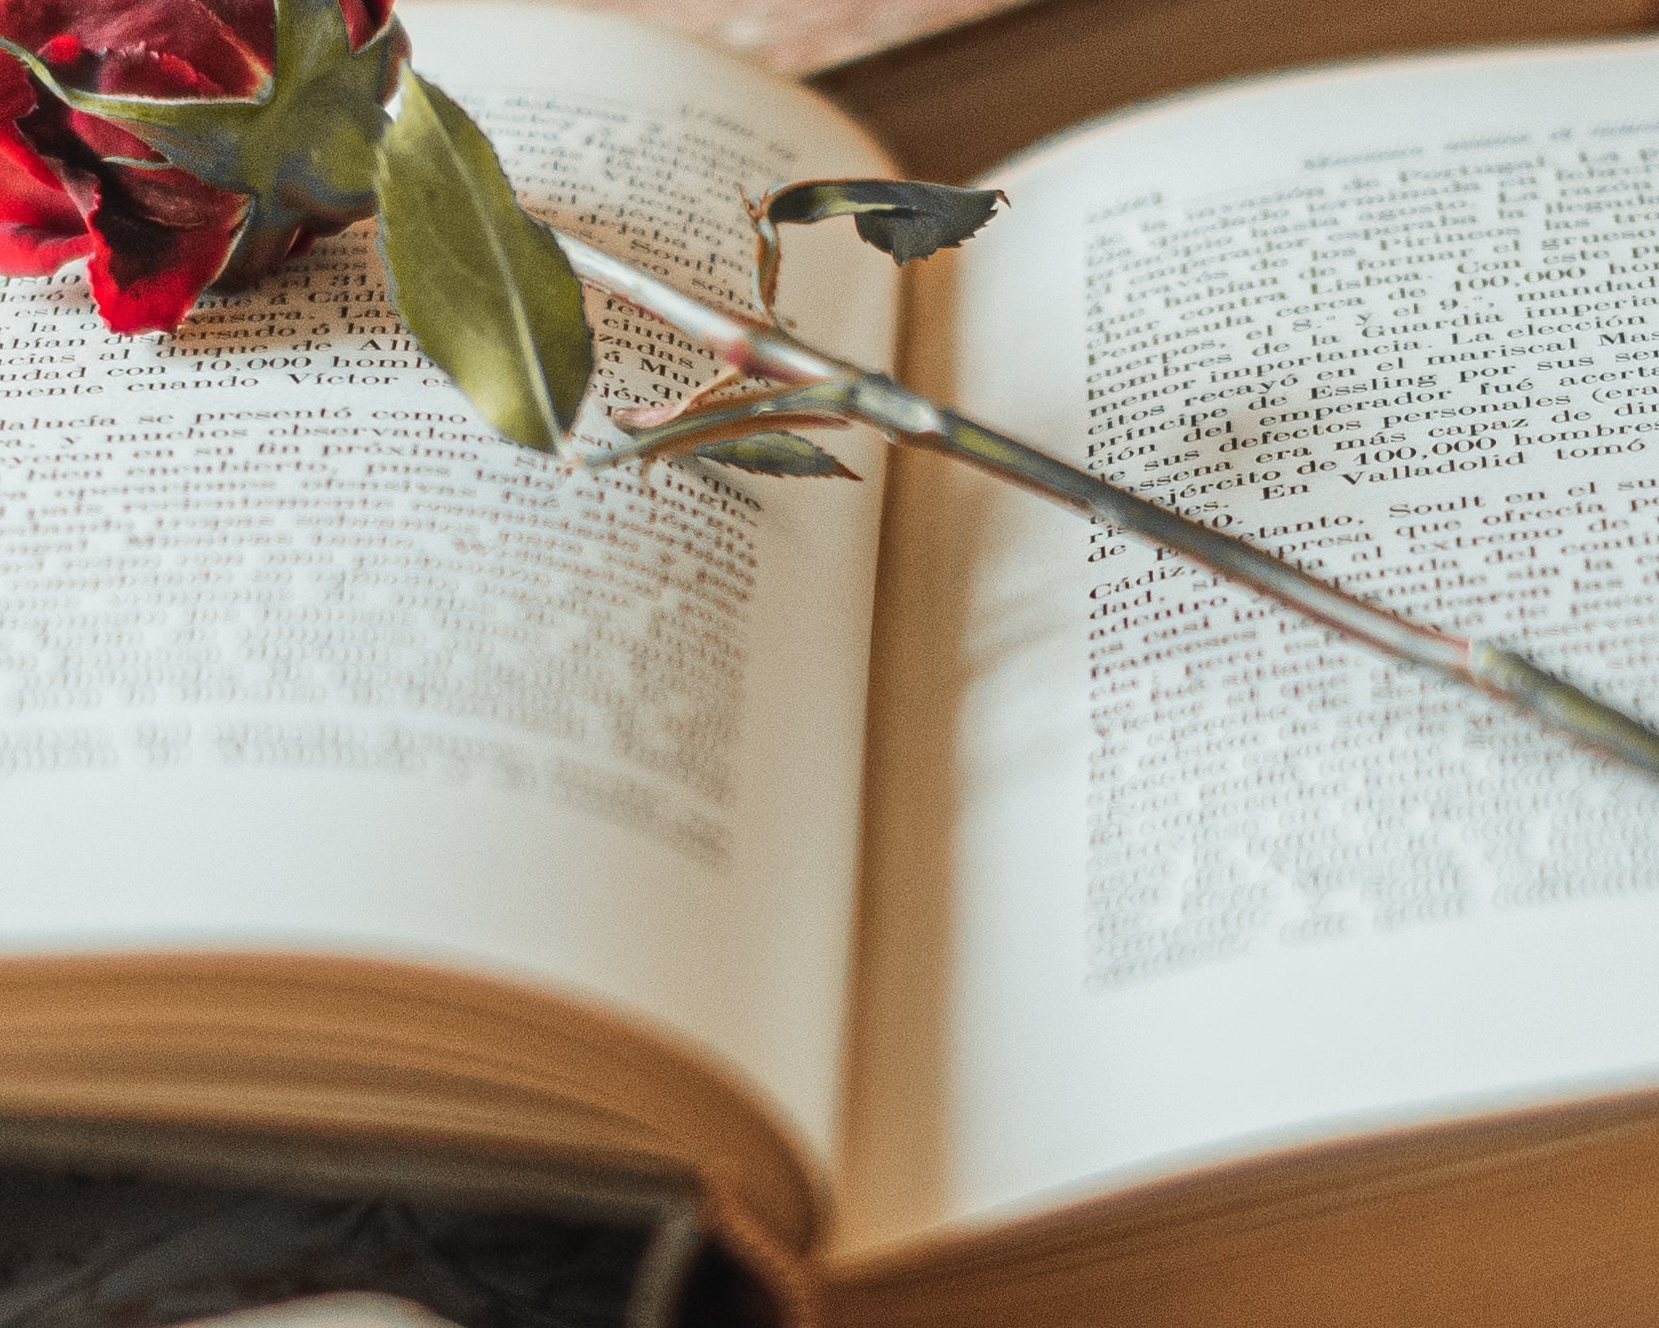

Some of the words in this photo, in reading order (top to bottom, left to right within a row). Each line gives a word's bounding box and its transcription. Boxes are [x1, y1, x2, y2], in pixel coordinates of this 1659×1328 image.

[30, 321, 57, 333] la
[98, 348, 131, 361] al
[155, 343, 269, 359] duque
[289, 338, 333, 352] de
[1089, 378, 1196, 418] menor
[1451, 332, 1492, 345] La
[1506, 314, 1646, 338] elección
[106, 365, 166, 376] con
[126, 374, 259, 391] cuando
[287, 372, 399, 385] Víctor
[1087, 404, 1166, 436] citos
[1184, 372, 1299, 407] recayó
[1316, 367, 1356, 381] en
[1376, 356, 1404, 372] el
[1427, 336, 1577, 366] mariscal
[139, 414, 174, 423] se
[195, 406, 352, 425] presentó
[371, 410, 468, 423] como
[1086, 443, 1157, 471] ción
[1182, 419, 1234, 443] del
[1258, 389, 1452, 427] emperador
[1480, 377, 1534, 395] fué
[1087, 407, 1228, 458] príncipe
[1247, 395, 1287, 411] de
[1310, 374, 1437, 400] Essling
[1459, 364, 1517, 383] por
[1537, 356, 1595, 371] sus
[106, 426, 247, 443] muchos
[1143, 449, 1200, 472] sus
[1218, 419, 1362, 453] defectos
[1383, 394, 1572, 429] personales
[1591, 385, 1659, 404] (era
[1255, 446, 1313, 464] era
[1335, 430, 1407, 451] más
[1427, 417, 1529, 438] capaz
[1550, 408, 1591, 424] de
[1262, 483, 1309, 500] En
[1340, 450, 1525, 486] Valladolid
[1556, 437, 1646, 460] tomó
[1296, 459, 1337, 475] de
[1358, 436, 1497, 466] 100,000
[1388, 495, 1481, 518] Soult
[1504, 490, 1546, 503] en
[1567, 480, 1597, 496] el
[1087, 544, 1126, 563] de
